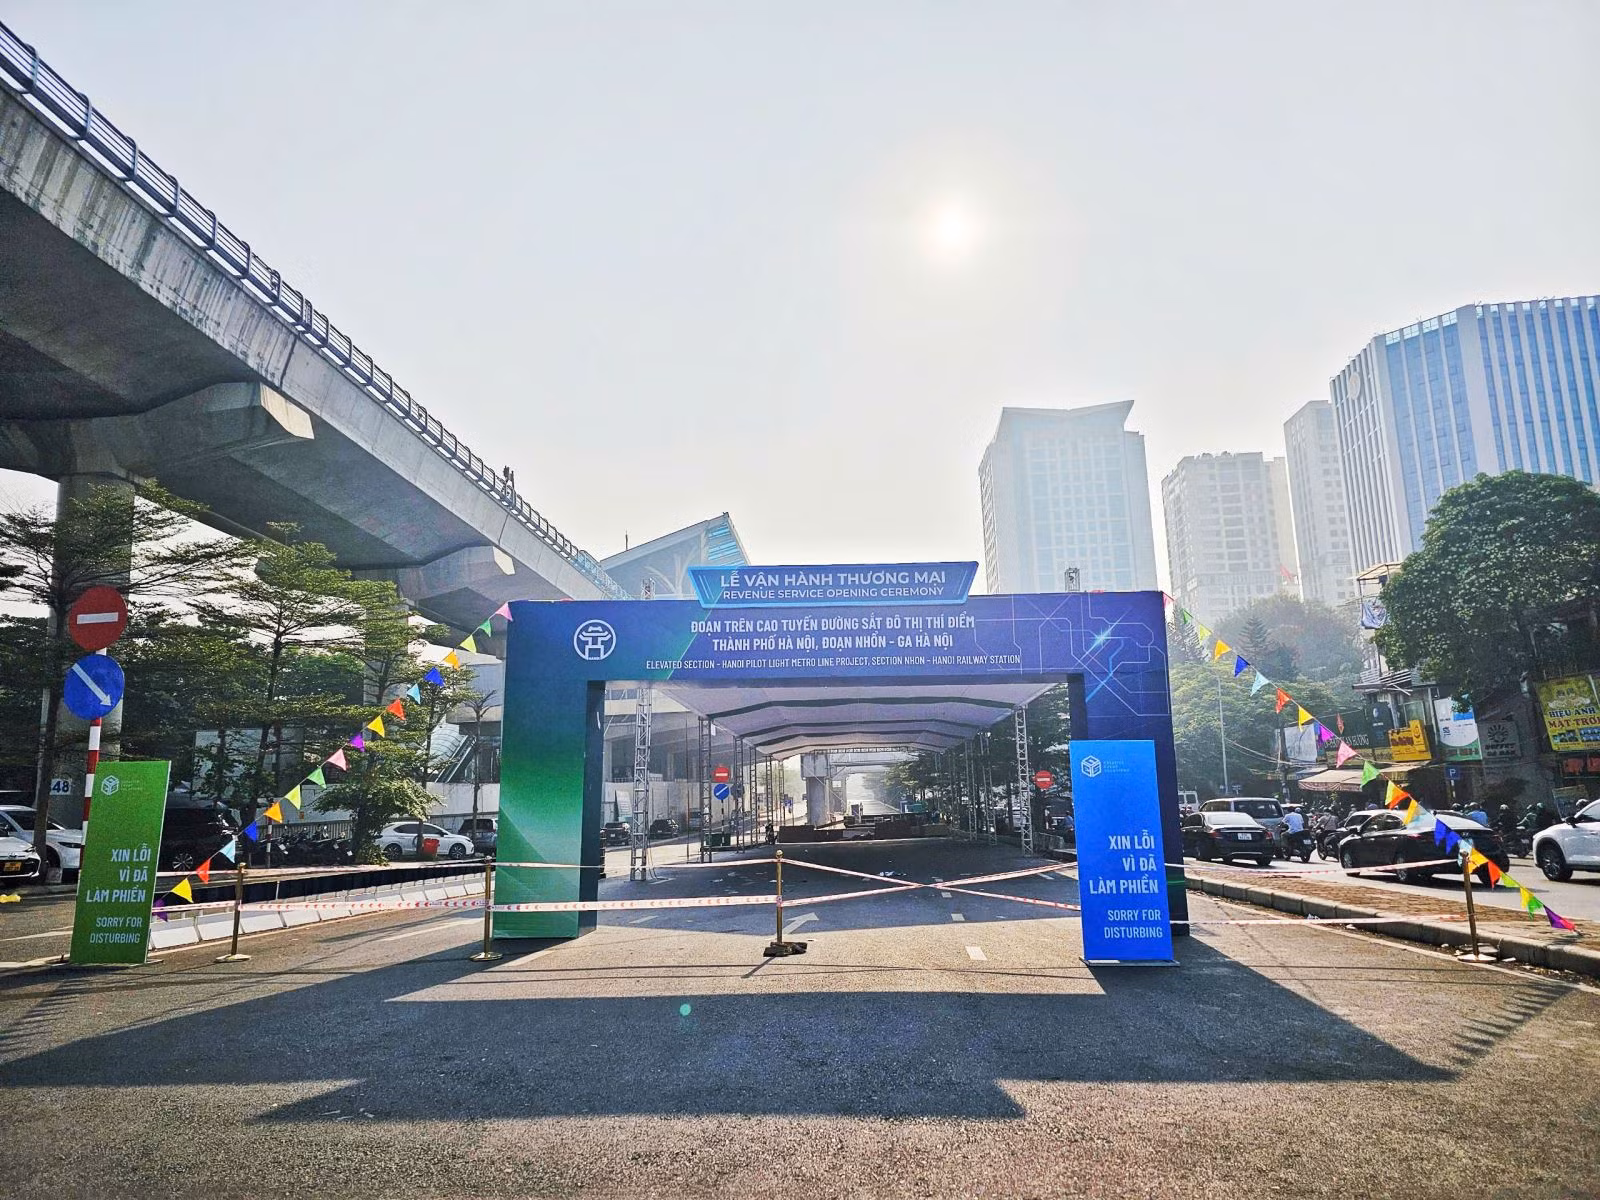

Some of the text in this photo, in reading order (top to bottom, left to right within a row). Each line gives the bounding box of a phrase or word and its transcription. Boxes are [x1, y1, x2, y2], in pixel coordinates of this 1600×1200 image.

[720, 570, 946, 590] LỄ VẬN HÀNH THƯƠNG MẠI
[723, 586, 944, 600] REVENUE SERVICE OPENING CEREMONY
[690, 610, 975, 637] ĐOẠN TRÊN CAO TUYẾN ĐƯỜNG SẮT ĐÔ THỊ THÍ ĐIỂM
[712, 635, 750, 651] THÀNH
[753, 634, 776, 650] PHỐ
[778, 635, 793, 650] HÀ
[796, 634, 819, 653] NỘI,
[822, 636, 852, 652] ĐOẠN
[855, 630, 886, 648] NHỔN
[898, 635, 913, 648] GA
[916, 632, 931, 647] HÀ
[934, 632, 954, 650] NỘI
[646, 660, 682, 670] ELEVATED
[684, 659, 715, 669] SECTION
[722, 659, 744, 668] HANOI
[746, 658, 766, 668] PILOT
[768, 658, 789, 668] LIGHT
[792, 658, 816, 668] METRO
[818, 658, 834, 667] LINE
[836, 657, 870, 667] PROJECT,
[872, 656, 903, 666] SECTION
[904, 656, 925, 665] NHON
[932, 656, 955, 665] HANOI
[956, 655, 988, 664] RAILWAY
[990, 654, 1021, 664] STATION
[1449, 768, 1456, 776] P
[52, 780, 70, 793] 48
[1108, 829, 1155, 850] XIN LỖI
[111, 843, 151, 862] XIN LỖI
[1122, 854, 1156, 872] VÌ ĐÃ
[119, 866, 148, 882] VÌ ĐÃ
[1089, 876, 1116, 895] LÀM
[86, 886, 110, 903] LÀM
[95, 916, 142, 928] SORRY FOR
[1108, 909, 1161, 921] SORRY FOR
[90, 932, 140, 944] DISTURBING
[1104, 926, 1163, 939] DISTURBING
